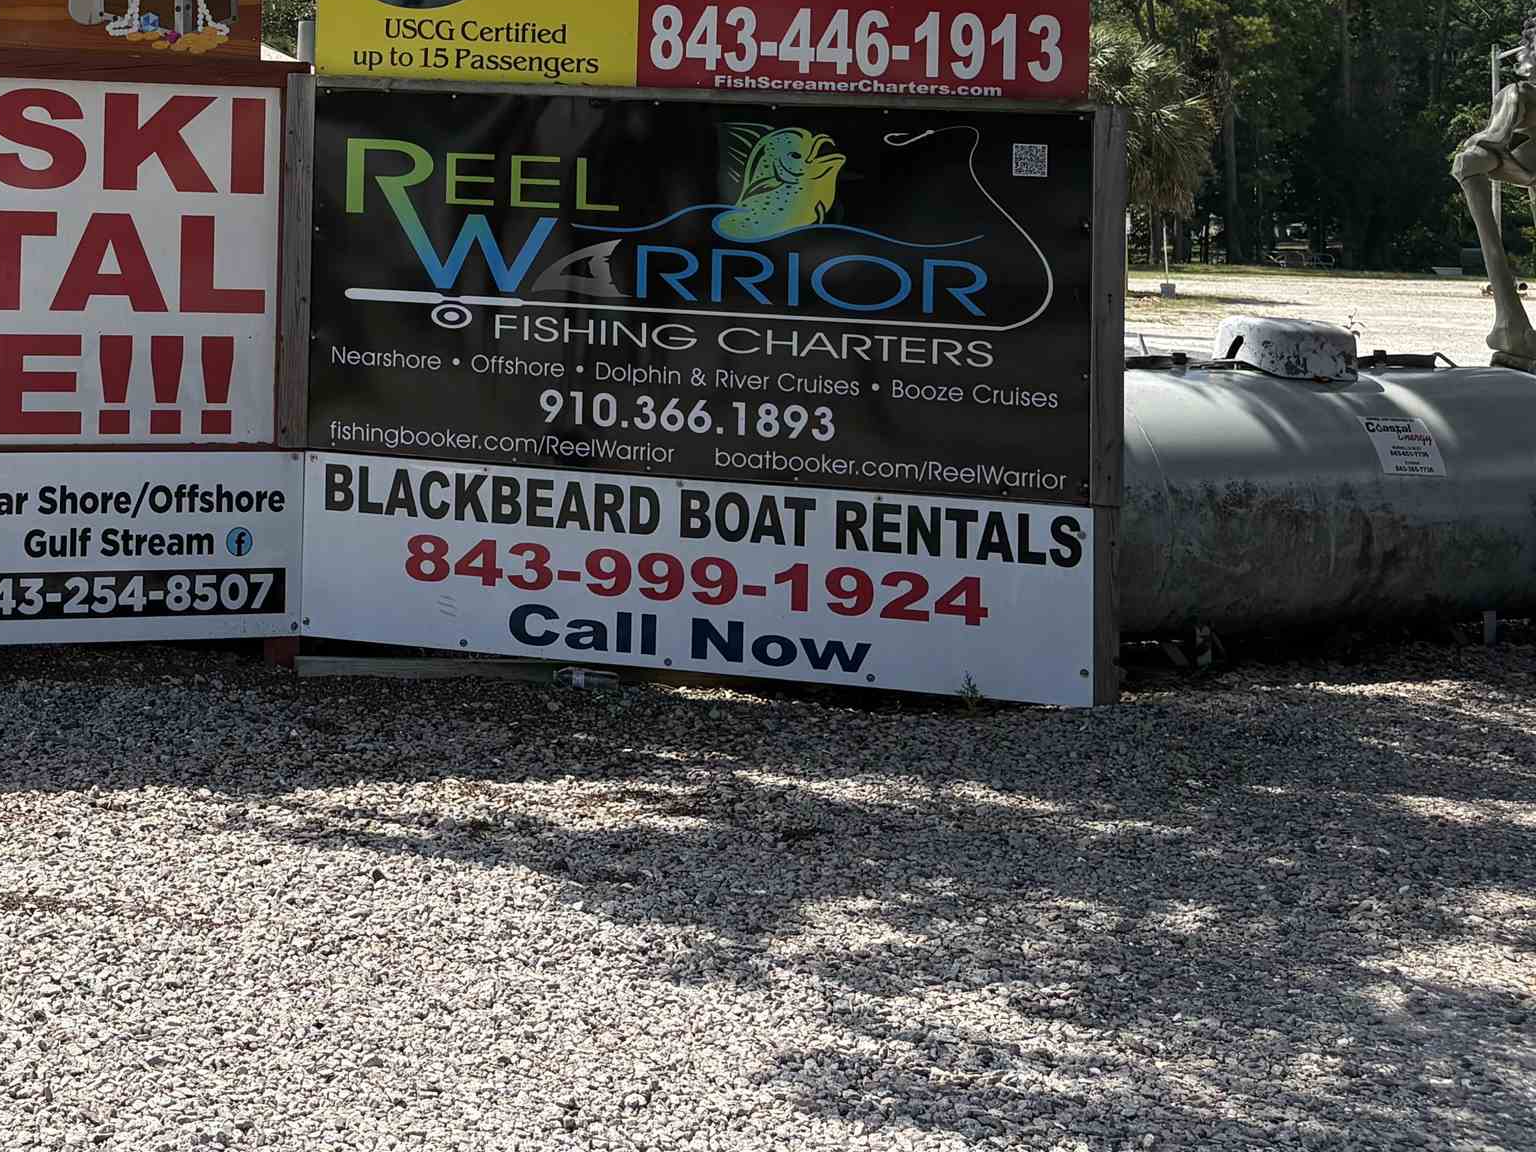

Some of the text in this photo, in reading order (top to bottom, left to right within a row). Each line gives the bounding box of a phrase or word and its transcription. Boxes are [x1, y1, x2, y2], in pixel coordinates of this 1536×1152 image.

[385, 18, 567, 44] USCG Certified
[650, 4, 1063, 83] 843-446-1913
[353, 48, 599, 78] up to 15 Passengers
[714, 75, 1002, 97] FishScreamerCharters.com
[345, 137, 620, 214] REEL
[494, 313, 994, 367] FISHING CHARTERS
[331, 346, 1058, 408] Nearshore Offshore Dolphin & River Cruises Booze Cruises
[330, 420, 673, 462] fishingbooker.com/ReelWarrior
[540, 389, 835, 441] 910.366.1893
[715, 448, 1067, 490] boatbooker.com/ReelWarrior
[38, 481, 285, 518] Shore/Offshore
[324, 464, 1084, 568] BLACKBEARD BOAT RENTALS
[24, 527, 91, 558] Gulf
[100, 528, 214, 556] Stream
[405, 534, 990, 626] 843-999-1924
[508, 603, 873, 673] Call Now
